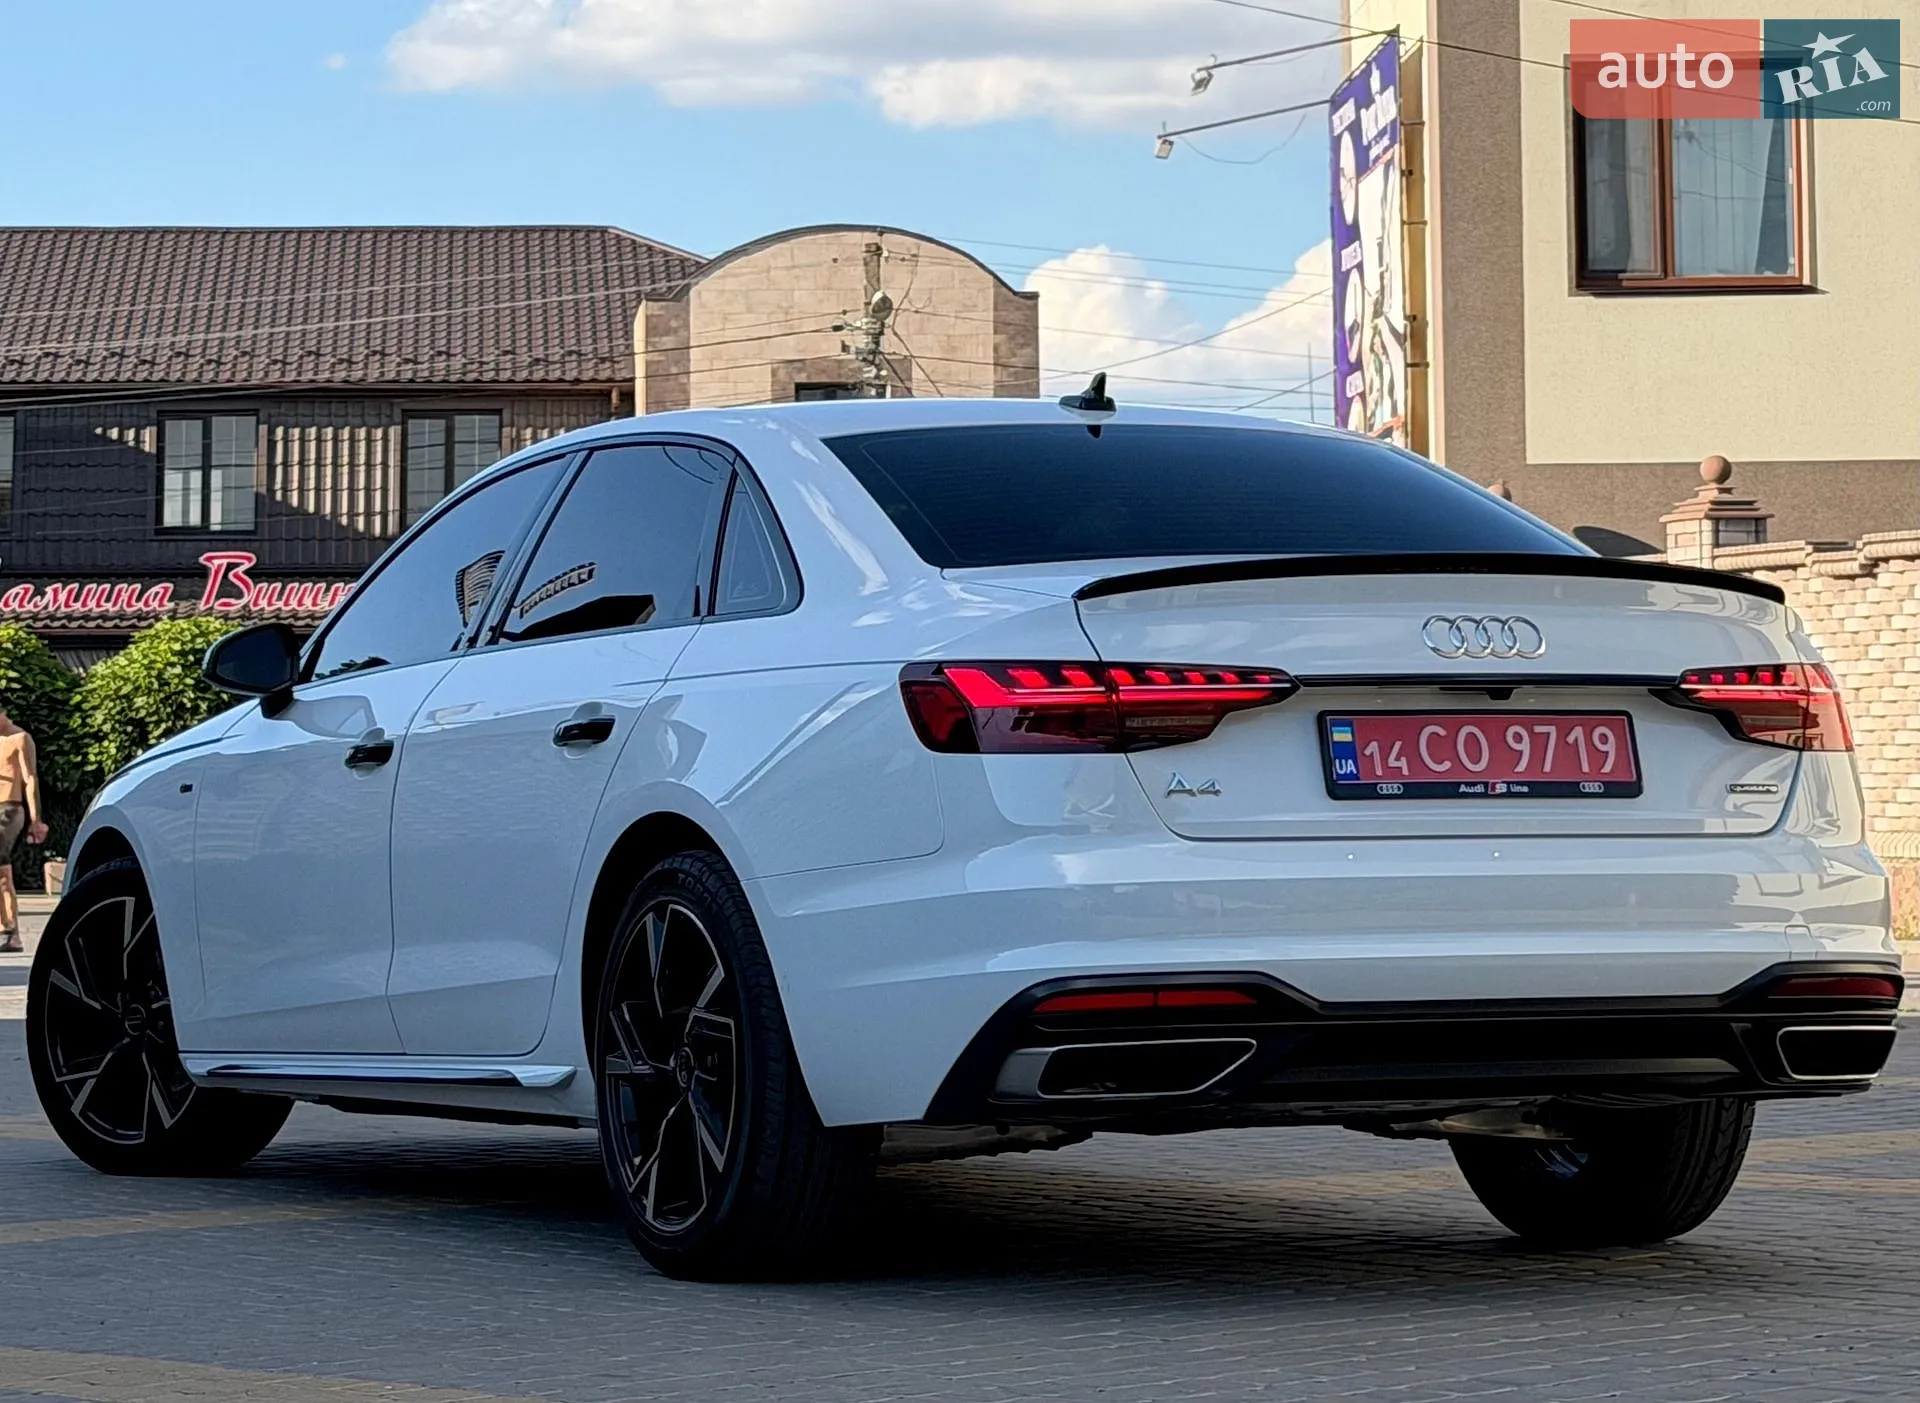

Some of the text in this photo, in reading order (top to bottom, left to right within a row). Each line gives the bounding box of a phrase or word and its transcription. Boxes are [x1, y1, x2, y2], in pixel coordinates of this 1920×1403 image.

[0, 582, 174, 612] амина
[1363, 724, 1617, 776] 14 CO 9719
[1336, 759, 1357, 775] UA
[1164, 771, 1223, 797] A4
[1459, 784, 1485, 793] Audi
[1510, 783, 1530, 793] line
